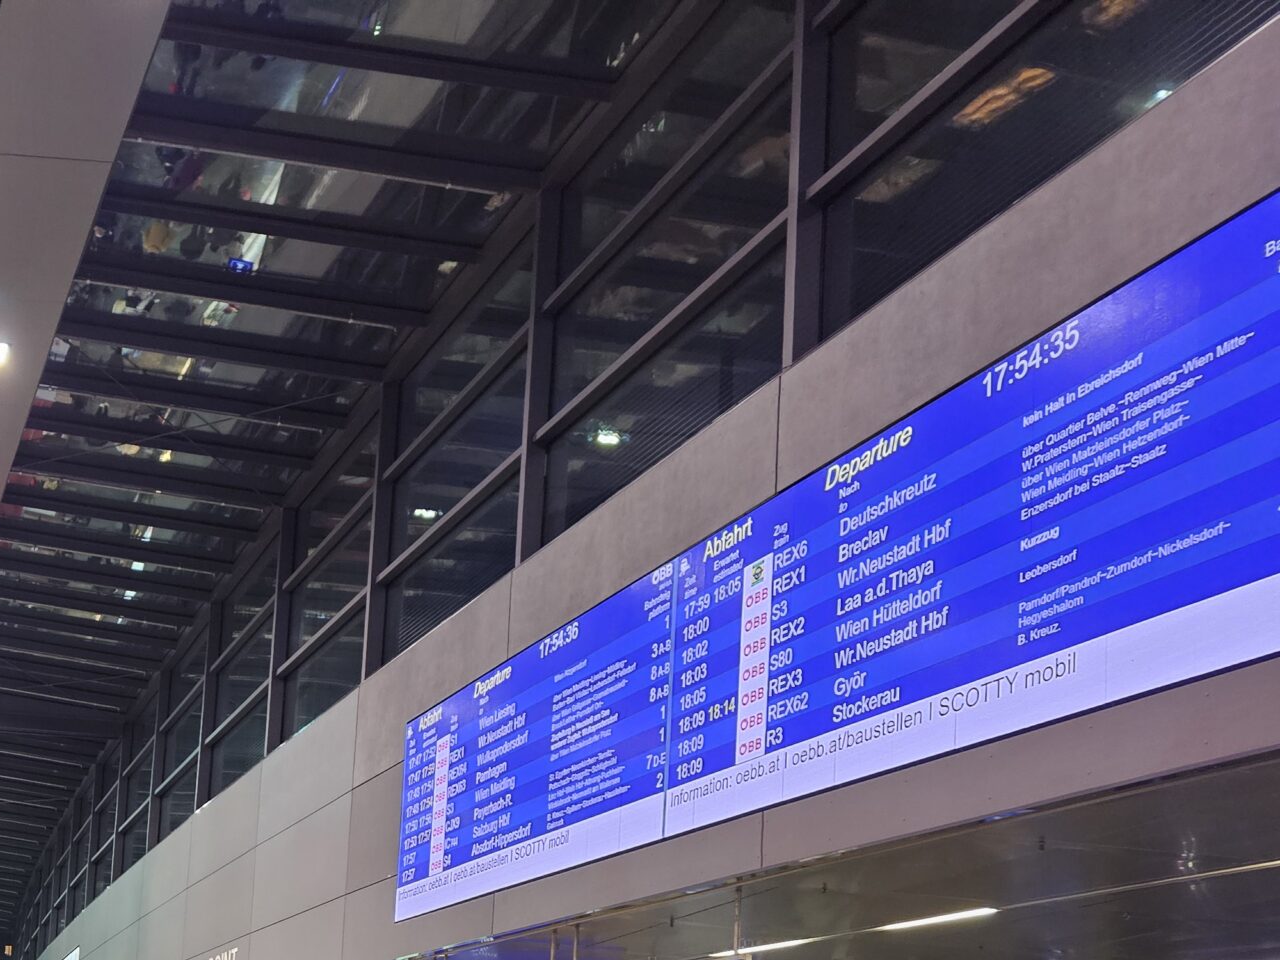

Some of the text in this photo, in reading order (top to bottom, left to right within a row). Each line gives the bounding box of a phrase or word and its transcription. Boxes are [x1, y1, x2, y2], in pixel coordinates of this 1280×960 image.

[982, 320, 1080, 397] 17:54:35
[1023, 352, 1144, 428] kein Halt in Ebreichsdorf
[824, 426, 913, 491] Departure
[1022, 473, 1043, 489] über
[1045, 458, 1070, 479] Wien
[1072, 421, 1151, 465] Matzleinsdorfer
[1023, 441, 1043, 458] über
[1046, 419, 1085, 446] Quartier
[838, 481, 860, 500] Nach
[839, 472, 937, 537] Deutschkreutz
[1021, 485, 1046, 503] Wien
[1021, 484, 1073, 521] Enzersdorf
[1074, 480, 1090, 497] bei
[703, 516, 753, 563] Abfahrt
[838, 525, 889, 563] Breclav
[838, 518, 952, 589] Wr.Neustadt Hbf
[1020, 526, 1060, 552] Kurzzug
[684, 540, 808, 620] 17:59 18:05 REX6
[1019, 549, 1078, 584] Leobersdorf
[682, 616, 710, 642] 18:00
[772, 565, 806, 597] REX1
[835, 580, 943, 643] Wien Hütteldorf
[836, 593, 862, 616] Laa
[1018, 595, 1084, 629] Hegyeshalom
[539, 622, 579, 659] 17:54:36
[680, 662, 708, 688] 18:03
[770, 617, 805, 647] REX2
[681, 639, 709, 665] 18:02
[771, 600, 788, 622] S3
[834, 606, 950, 669] Wr.Neustadt Hbf
[1017, 633, 1028, 646] B.
[473, 666, 512, 699] Departure
[678, 710, 705, 734] 18:09
[708, 696, 736, 722] 18:14
[769, 668, 803, 697] REX3
[680, 686, 707, 711] 18:05
[770, 648, 793, 672] S80
[832, 686, 901, 724] Stockerau
[671, 775, 732, 807] Information:
[736, 758, 780, 785] oebb.at
[792, 708, 922, 768] oebb.at/baustellen
[938, 672, 1019, 717] SCOTTY
[1024, 651, 1076, 689] mobil
[677, 733, 704, 758] 18:09
[768, 691, 809, 723] REX62
[676, 757, 703, 781] 18:09
[766, 726, 784, 748] R3
[656, 773, 664, 789] 2
[473, 817, 498, 838] Salzburg
[514, 839, 547, 861] SCOTTY
